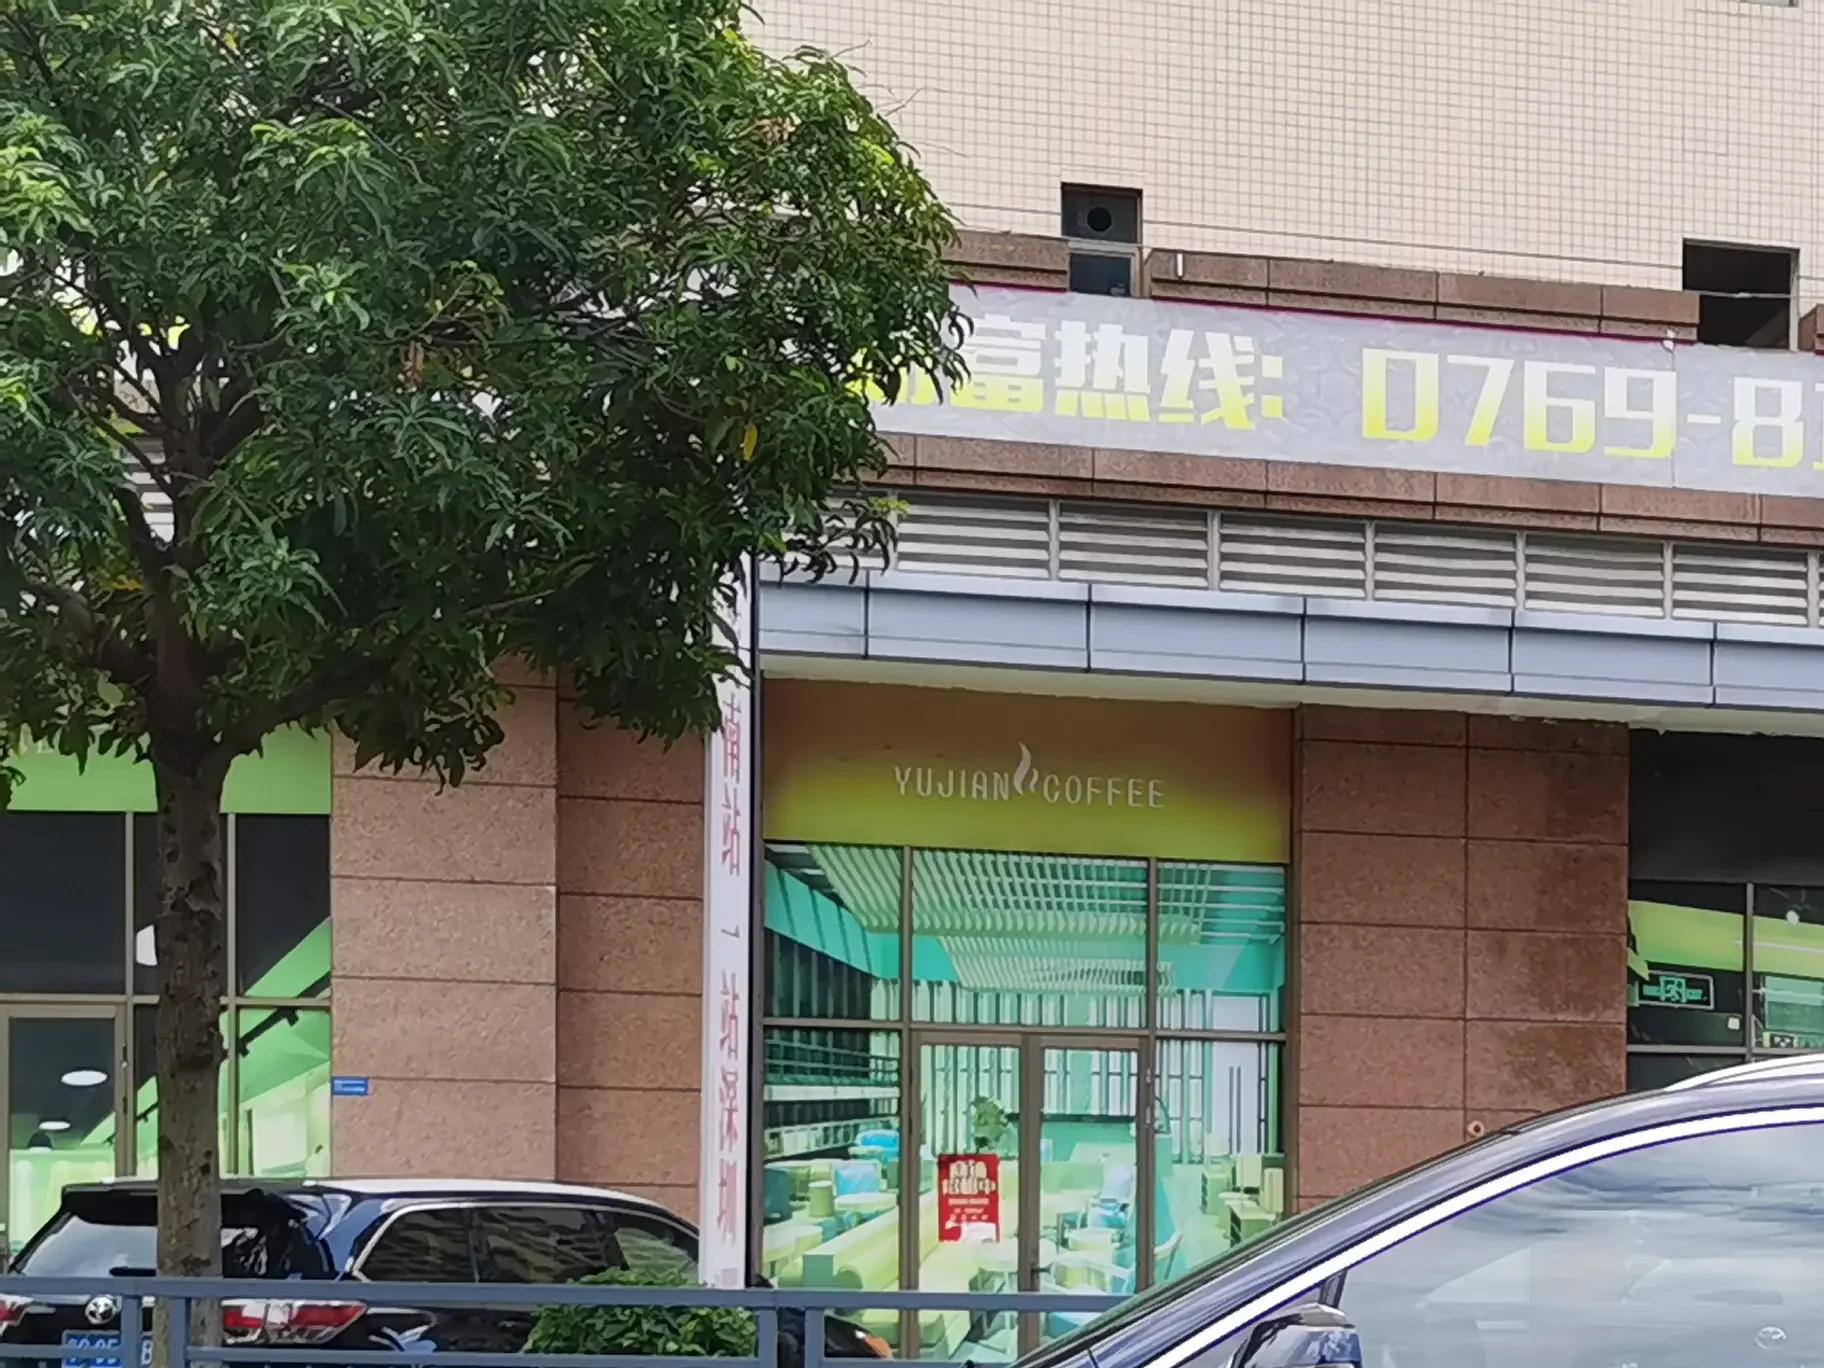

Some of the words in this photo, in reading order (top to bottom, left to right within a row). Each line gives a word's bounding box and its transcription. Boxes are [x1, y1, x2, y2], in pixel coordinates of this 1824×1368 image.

[843, 313, 1283, 430] 富热线:
[894, 765, 1010, 801] YUJIAN
[1043, 774, 1165, 809] COFFEE
